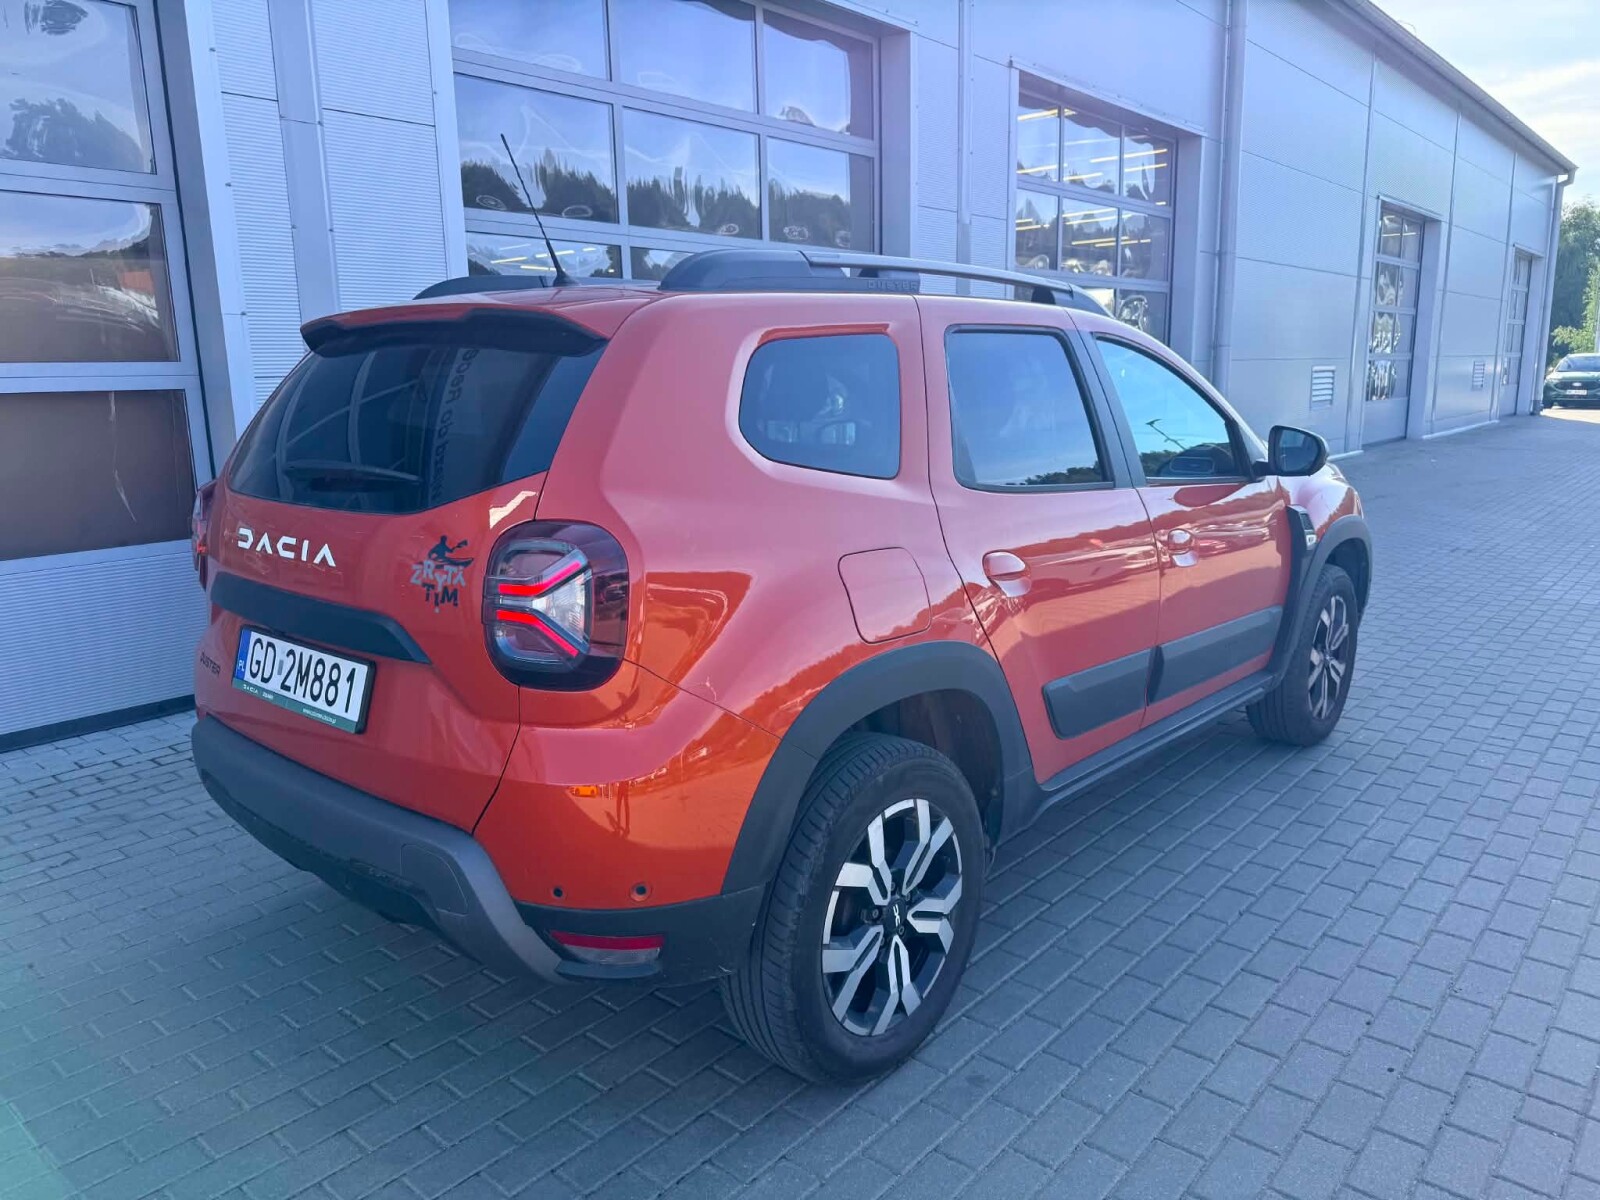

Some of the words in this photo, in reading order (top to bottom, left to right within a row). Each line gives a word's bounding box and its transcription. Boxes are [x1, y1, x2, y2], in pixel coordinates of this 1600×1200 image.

[238, 527, 336, 567] DACIA
[249, 638, 276, 684] GD
[280, 649, 356, 713] 2M881
